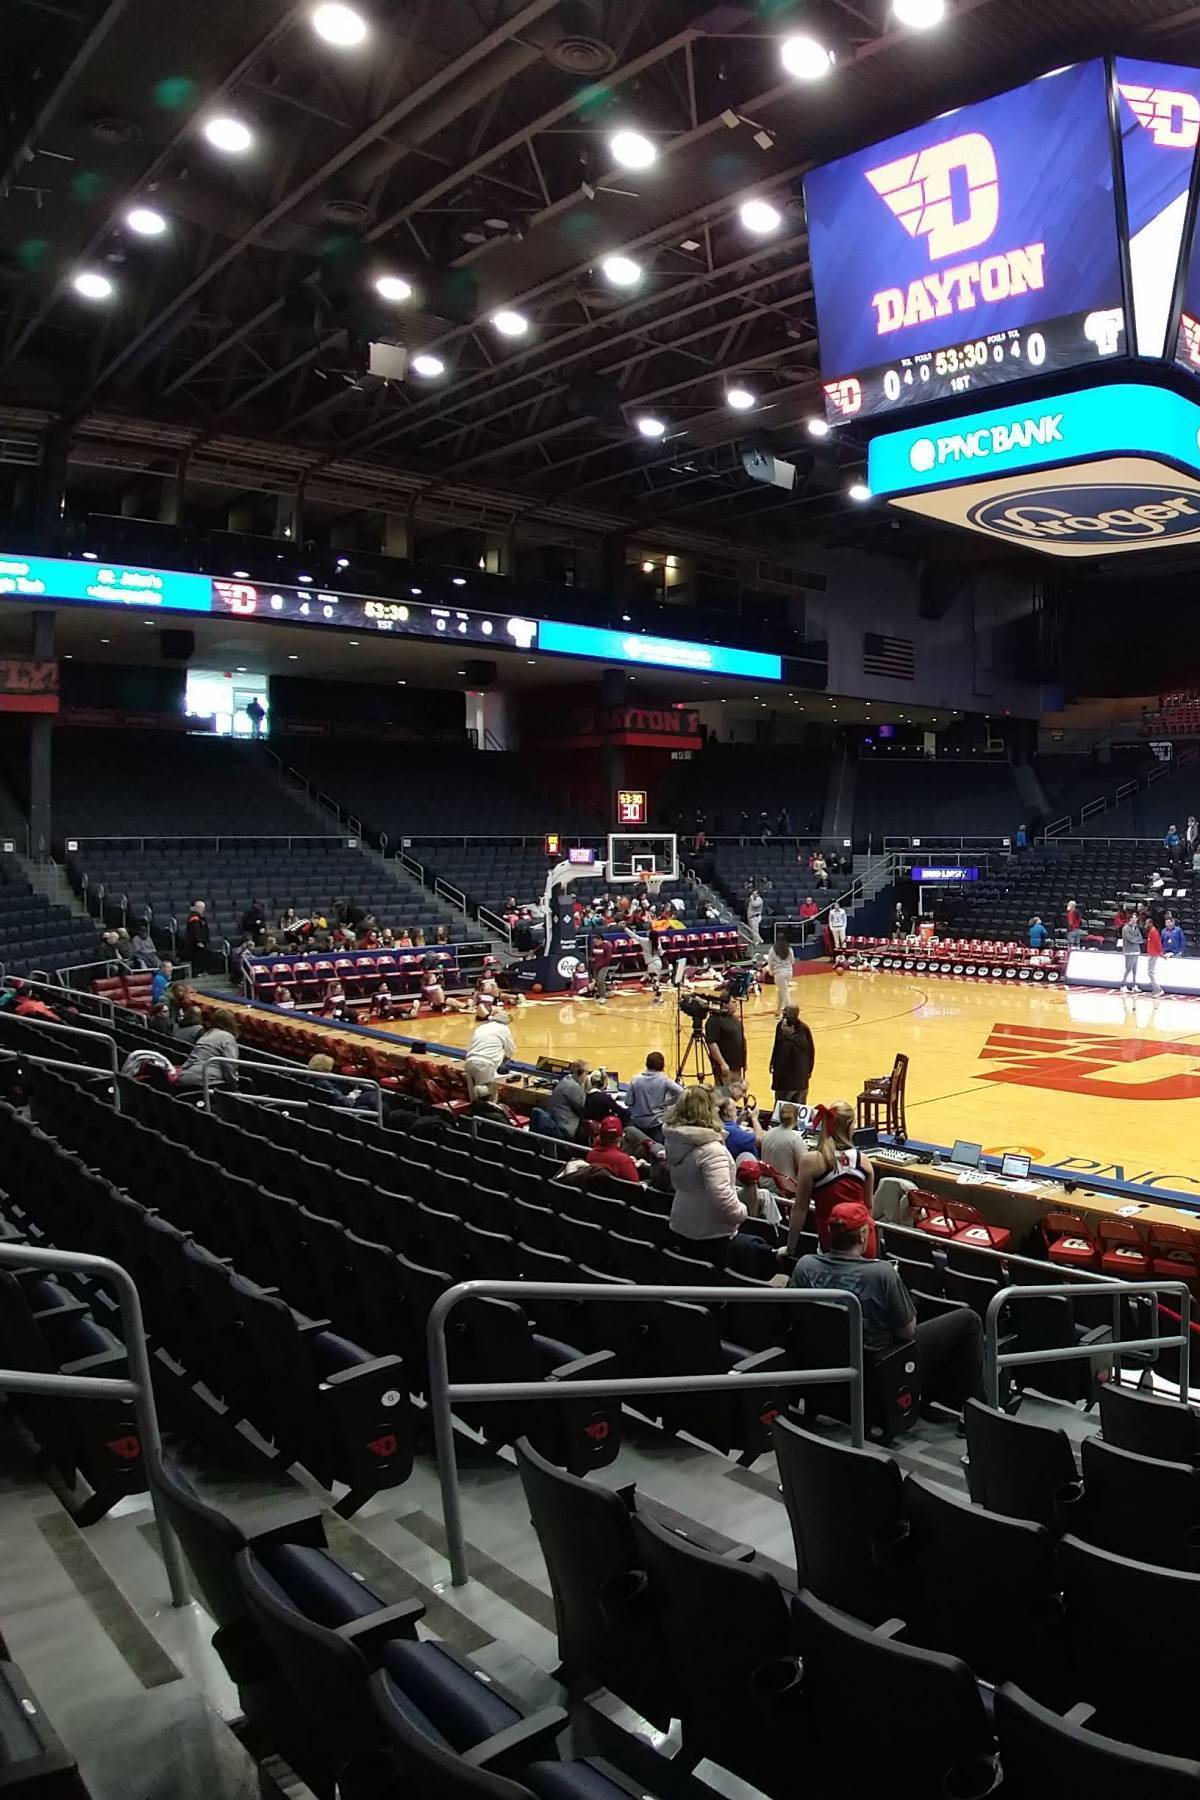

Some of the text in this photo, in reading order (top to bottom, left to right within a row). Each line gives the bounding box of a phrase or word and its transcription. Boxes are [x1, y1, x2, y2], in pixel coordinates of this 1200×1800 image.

[872, 244, 1046, 336] DAYTON
[884, 370, 900, 401] 0
[935, 341, 988, 375] 53:30
[1027, 333, 1046, 365] 0
[937, 413, 1064, 465] PNC BANK
[622, 804, 640, 820] 30
